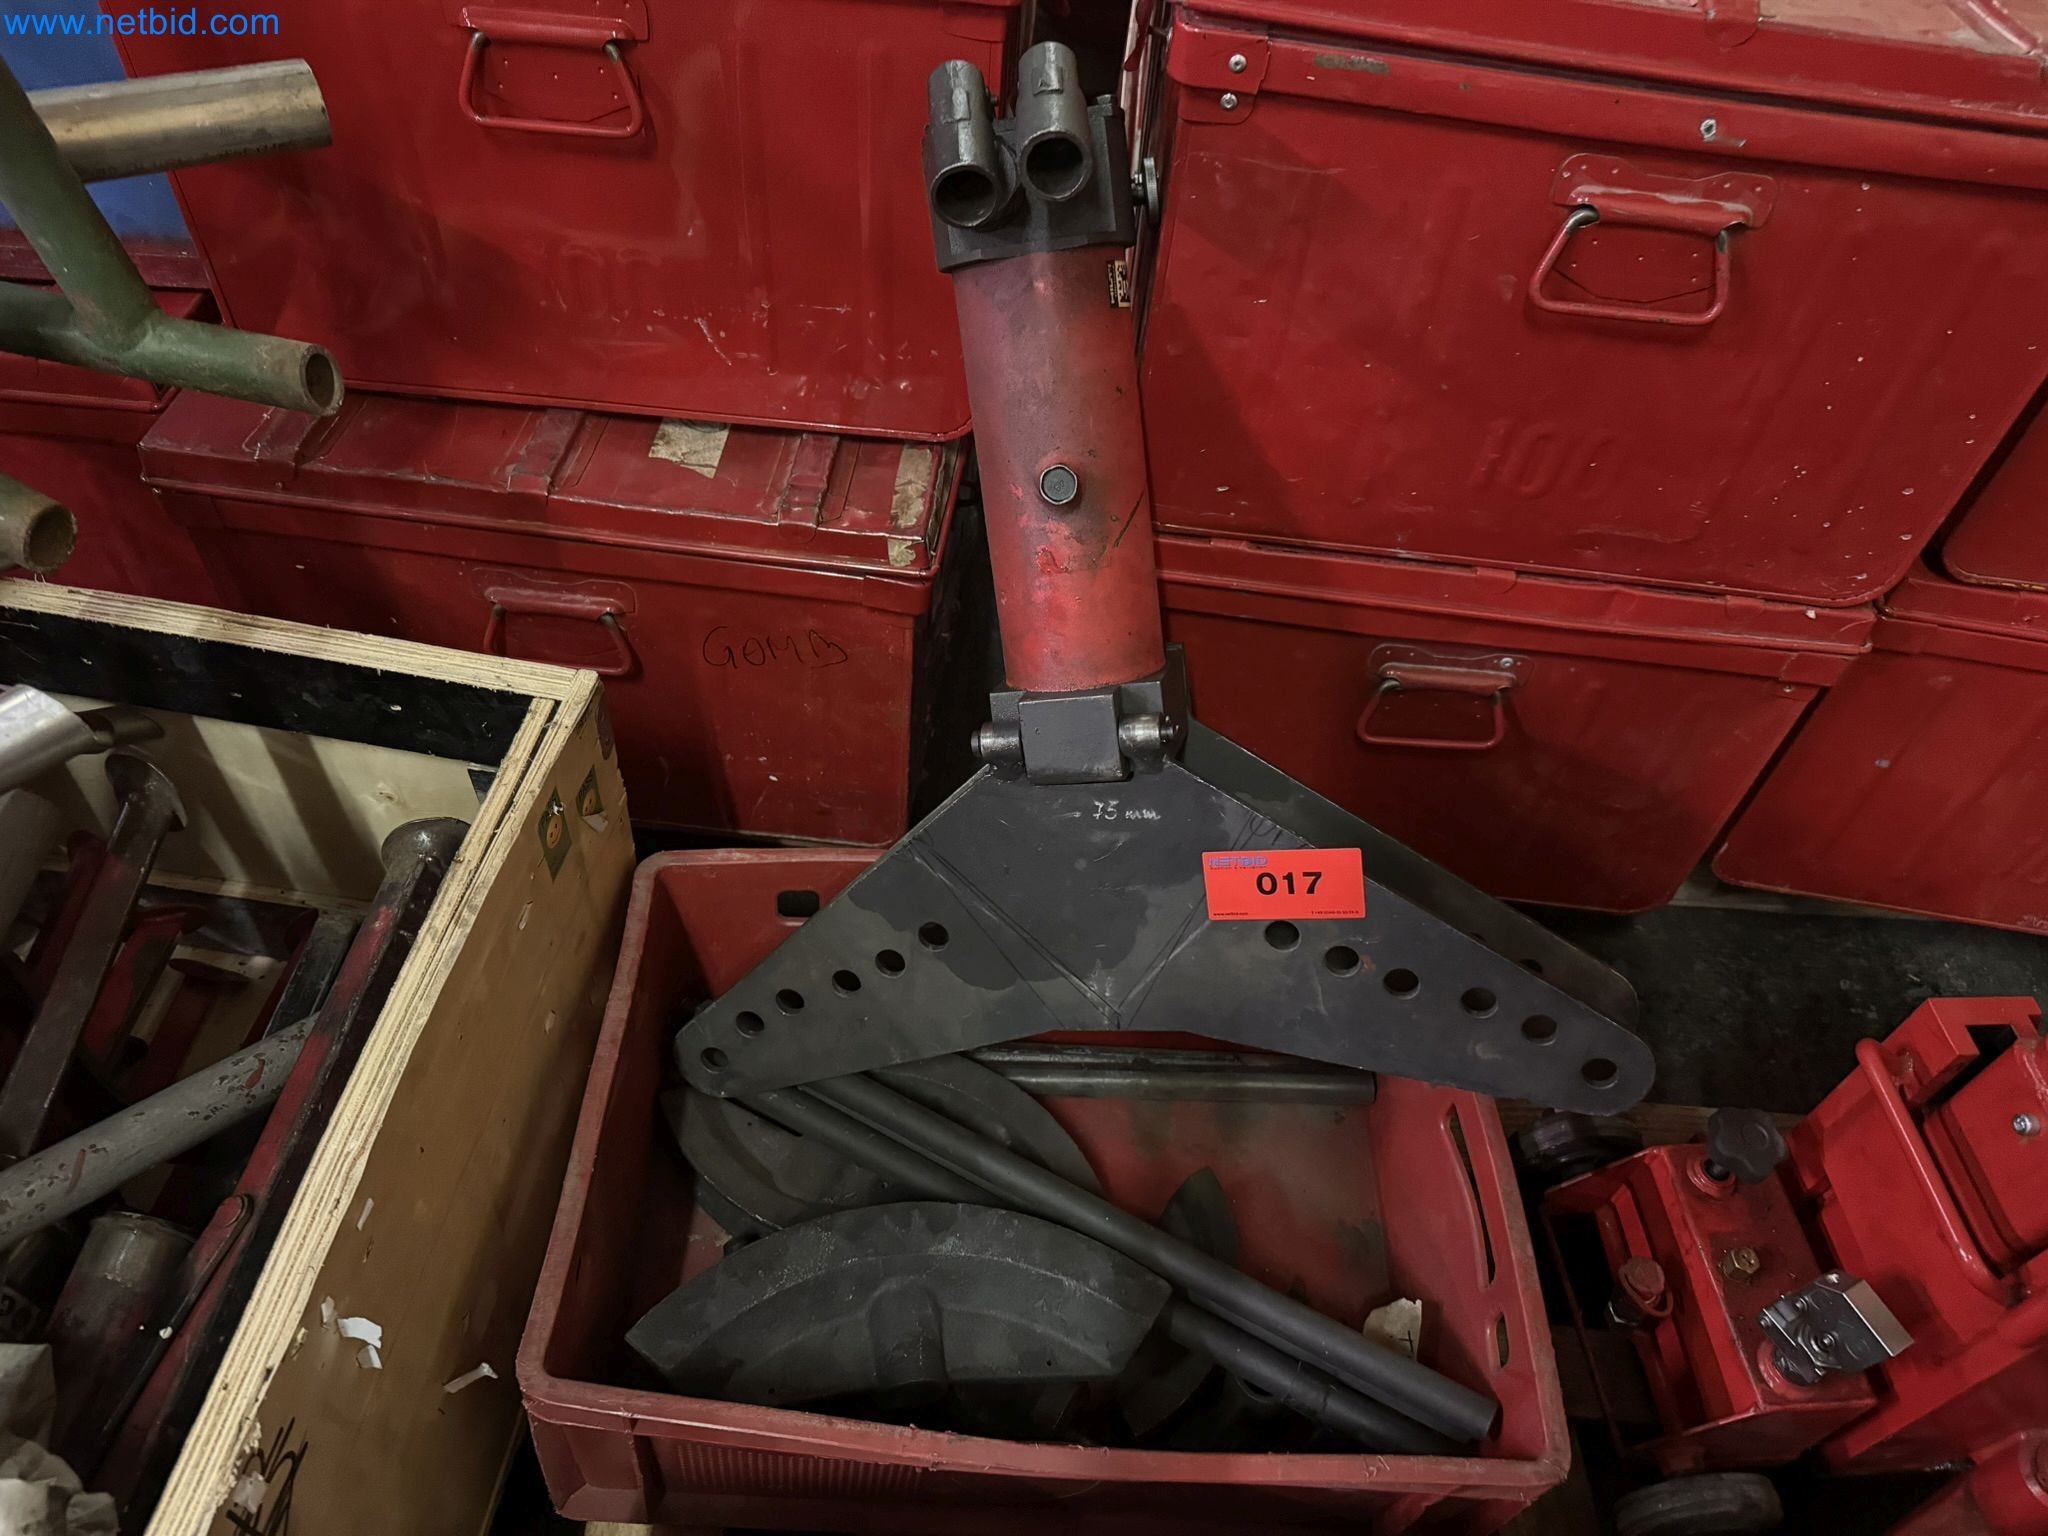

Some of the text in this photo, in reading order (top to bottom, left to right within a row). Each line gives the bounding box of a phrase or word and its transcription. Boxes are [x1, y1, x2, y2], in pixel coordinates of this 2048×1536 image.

[1093, 800, 1119, 820] 75
[1209, 856, 1268, 867] NETBID
[1256, 872, 1322, 895] 017
